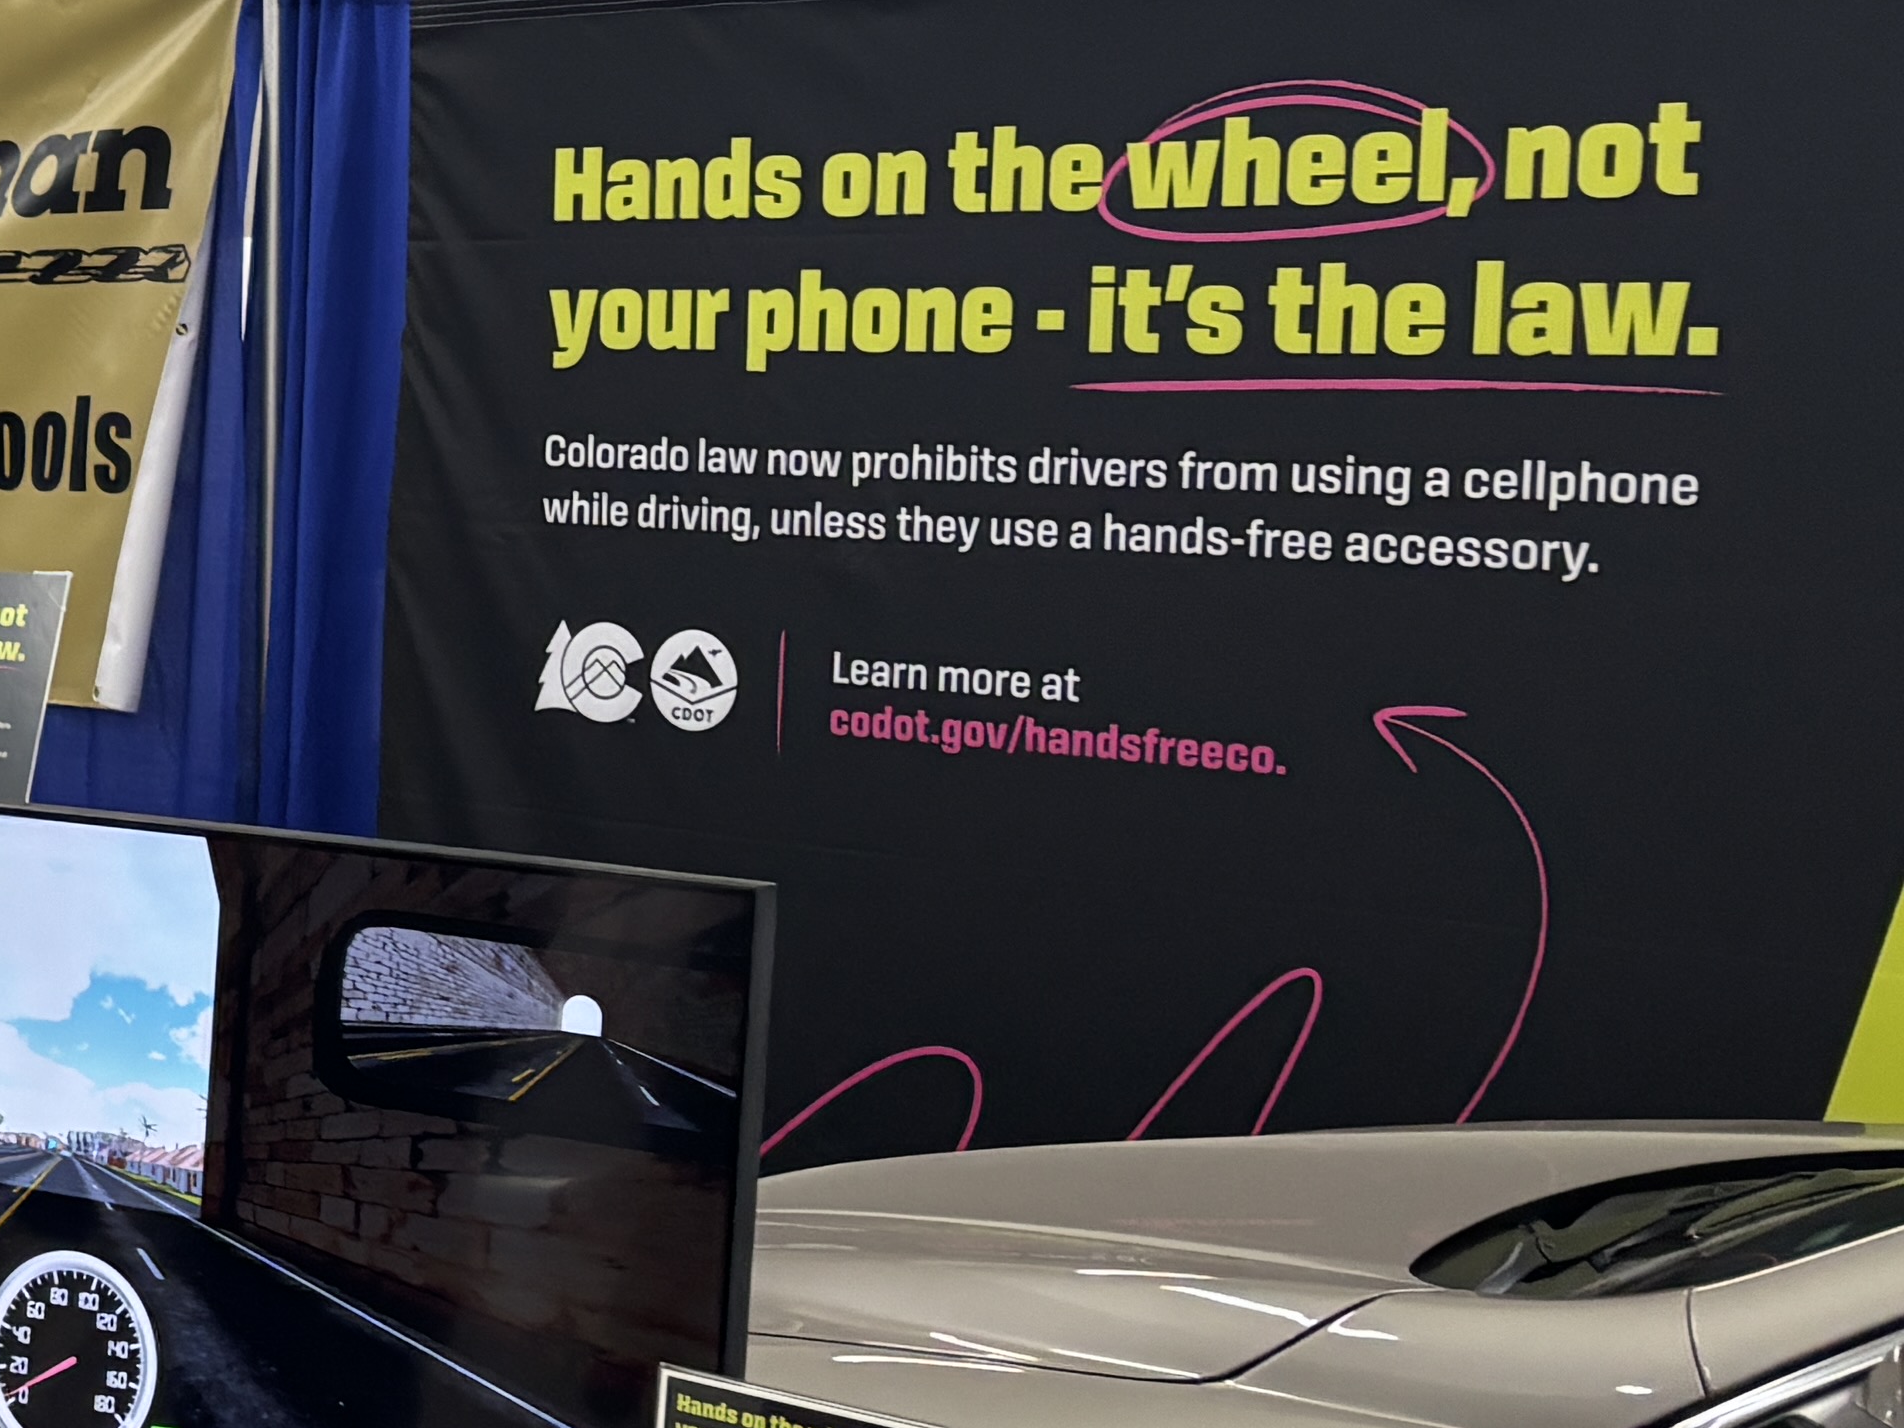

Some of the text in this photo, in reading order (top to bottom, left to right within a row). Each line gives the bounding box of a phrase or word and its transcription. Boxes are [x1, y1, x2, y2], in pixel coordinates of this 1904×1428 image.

[553, 102, 1702, 222] Hands on the wheel, not
[549, 260, 1720, 372] your phone - it's the law.
[544, 433, 1700, 511] Colorado law now prohibits drivers from using a cellphone
[543, 492, 1599, 583] while driving, unless they use a hands-free accessory.
[832, 651, 1081, 703] Learn more at
[671, 706, 715, 724] CDOT
[829, 706, 1287, 775] codot.gov/handsfreeco.
[50, 1287, 68, 1306] 80
[78, 1292, 99, 1311] 100
[26, 1300, 45, 1320] 60
[12, 1326, 31, 1345] 40
[107, 1340, 129, 1359] 140
[9, 1356, 28, 1375] 20
[106, 1371, 128, 1390] 160
[18, 1386, 29, 1405] 0
[676, 1393, 738, 1426] Hands
